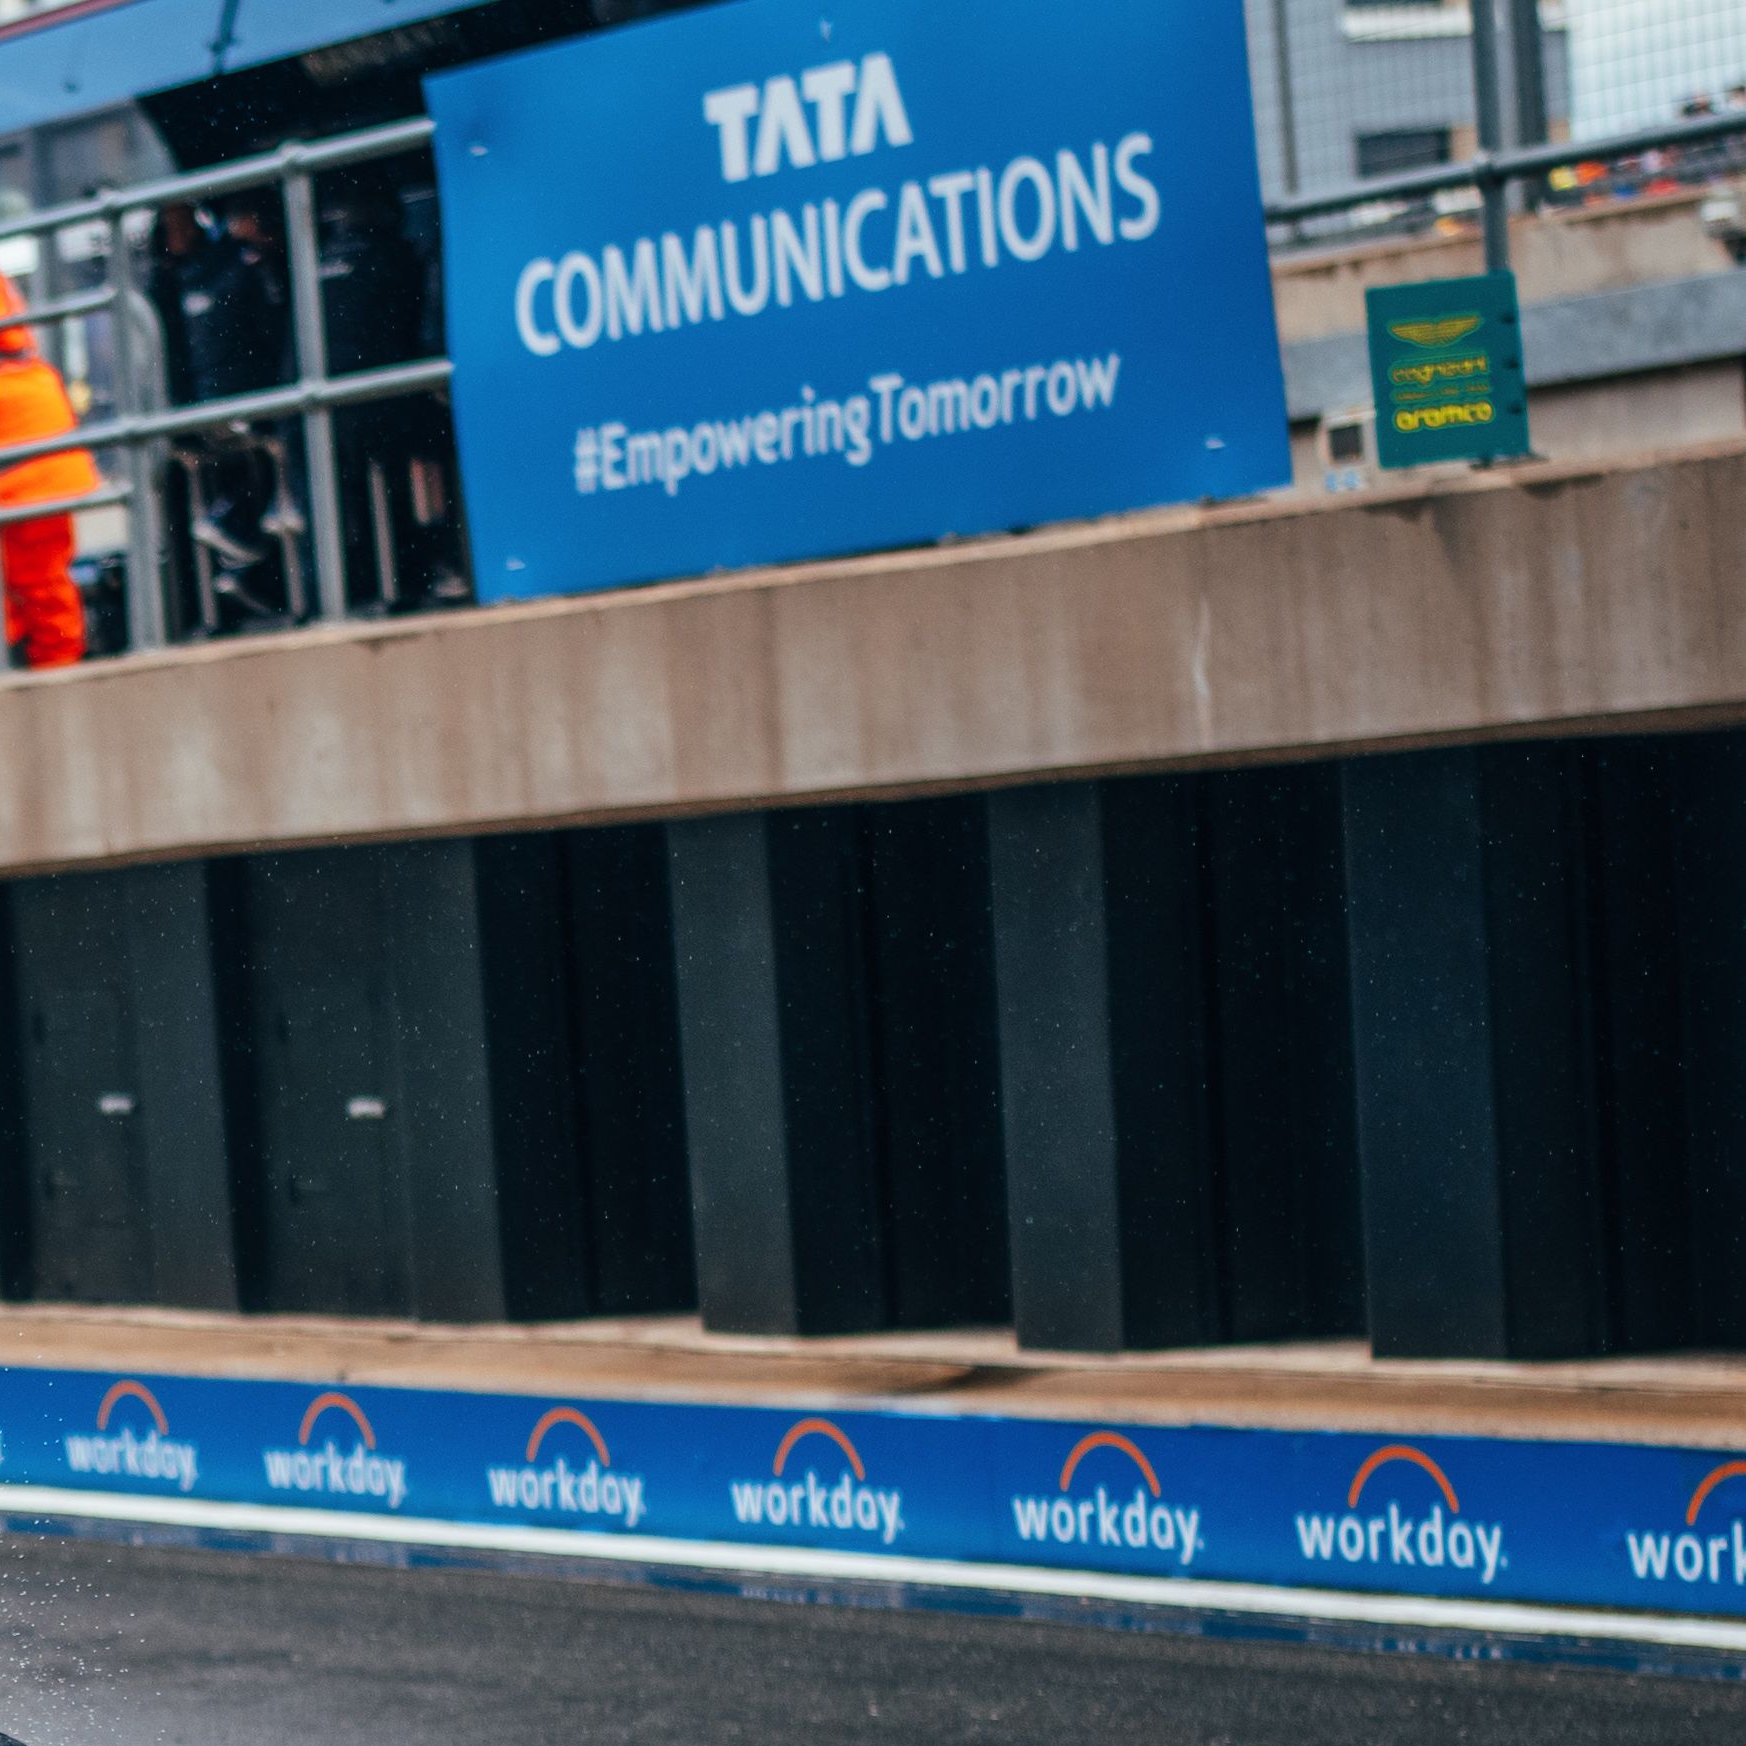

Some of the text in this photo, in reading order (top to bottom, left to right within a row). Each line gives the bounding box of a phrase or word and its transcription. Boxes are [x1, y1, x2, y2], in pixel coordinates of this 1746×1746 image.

[703, 51, 914, 184] TATA
[513, 131, 1161, 357] COMMUNICATIONS
[573, 352, 1121, 498] #EmpoweringTomorrow
[1396, 402, 1492, 430] aramco
